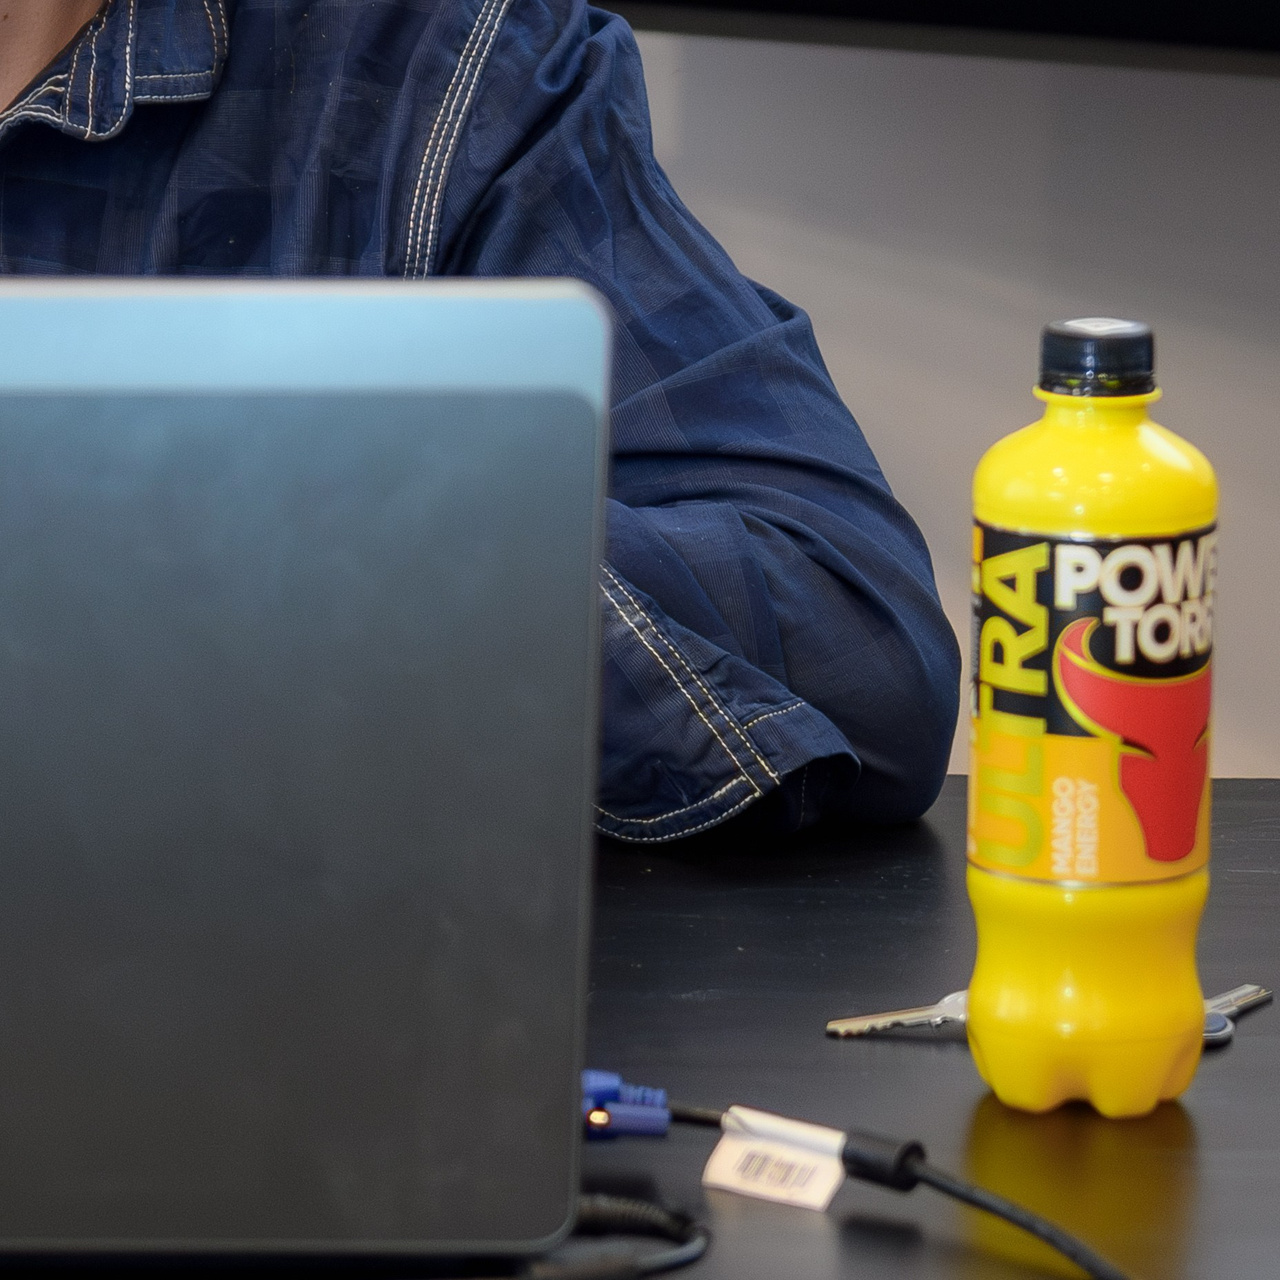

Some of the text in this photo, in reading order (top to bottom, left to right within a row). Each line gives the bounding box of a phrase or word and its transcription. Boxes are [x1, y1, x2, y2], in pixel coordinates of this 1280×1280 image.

[1102, 600, 1212, 664] TOR
[978, 542, 1050, 868] ULTRA
[1051, 776, 1075, 876] MANGO
[1075, 777, 1100, 878] ENERGY
